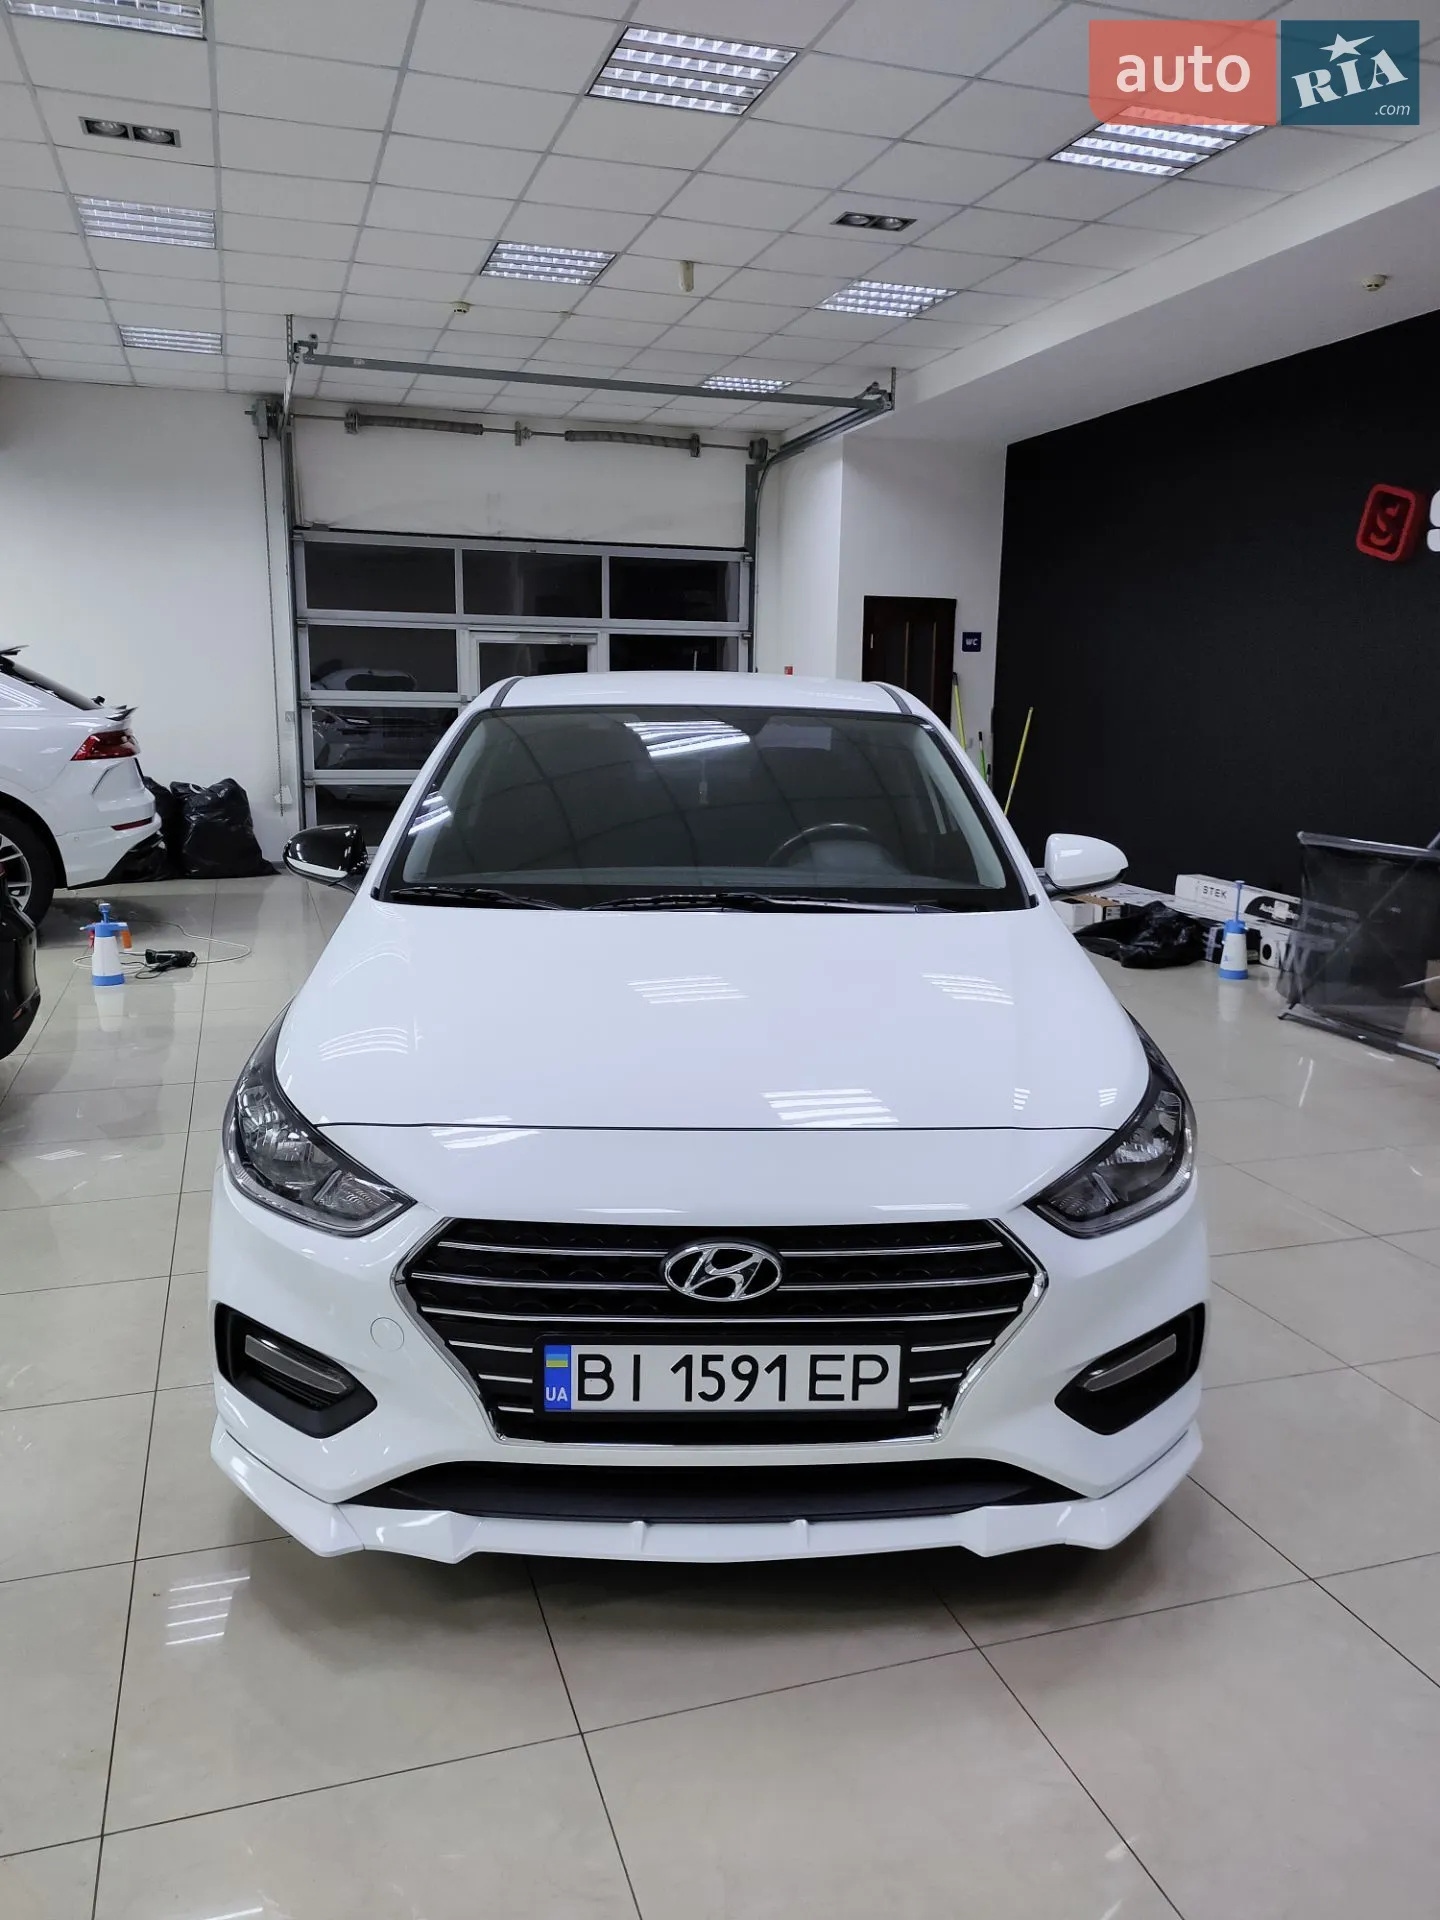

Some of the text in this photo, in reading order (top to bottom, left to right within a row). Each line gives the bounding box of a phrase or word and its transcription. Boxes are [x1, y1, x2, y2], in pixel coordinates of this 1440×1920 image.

[965, 638, 979, 646] WC
[1202, 885, 1228, 899] STEK
[577, 1353, 890, 1402] BI 1591 EP
[545, 1386, 569, 1402] UA
